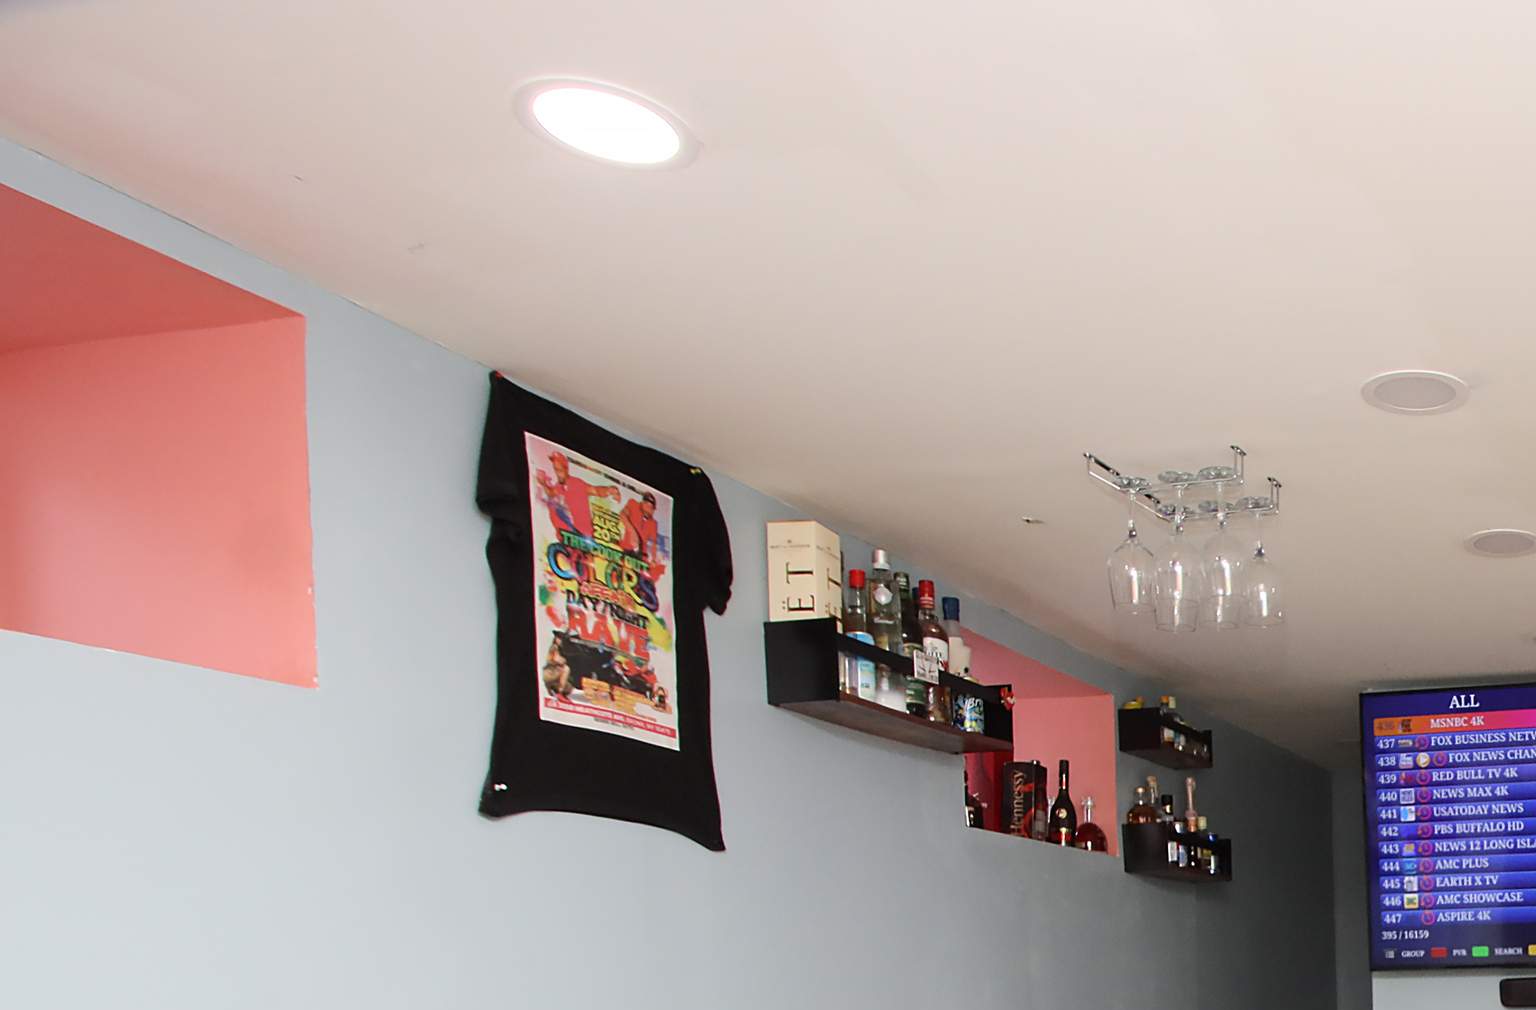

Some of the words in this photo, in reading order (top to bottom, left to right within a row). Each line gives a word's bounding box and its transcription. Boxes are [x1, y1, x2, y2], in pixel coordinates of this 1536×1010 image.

[547, 543, 659, 612] COLORS
[567, 605, 650, 661] RAVE
[1449, 694, 1479, 708] ALL
[1430, 716, 1468, 728] MSNBC
[1470, 716, 1484, 726] 4K
[1377, 739, 1395, 748] 437
[1431, 736, 1452, 746] FOX
[1455, 733, 1506, 744] BUSINESS
[1378, 756, 1396, 766] 438
[1449, 753, 1470, 763] FOX
[1472, 751, 1505, 762] NEWS
[1378, 774, 1396, 784] 439
[1432, 771, 1454, 781] RED
[1456, 769, 1484, 780] BULL
[1487, 768, 1501, 778] TV
[1504, 767, 1518, 777] 4K
[1379, 792, 1397, 801] 440
[1433, 788, 1465, 799] NEWS
[1467, 786, 1492, 797] MAX
[1495, 785, 1508, 795] 4K
[1010, 769, 1026, 837] Hennessy
[1379, 810, 1397, 819] 441
[1434, 804, 1489, 817] USATODAY
[1491, 803, 1524, 814] NEWS
[1381, 827, 1398, 836] 442
[1434, 824, 1453, 834] PBS
[1456, 822, 1505, 834] BUFFALO
[1507, 821, 1524, 831] HD
[1381, 844, 1399, 854] 443
[1435, 841, 1466, 852] NEWS
[1469, 840, 1481, 850] 12
[1484, 838, 1514, 849] LONG
[1382, 863, 1400, 872] 444
[1435, 859, 1460, 869] AMC
[1462, 858, 1489, 869] PLUS
[1383, 880, 1400, 889] 445
[1436, 876, 1472, 887] EARTH
[1475, 876, 1483, 885] X
[1484, 875, 1498, 885] TV
[1383, 897, 1401, 906] 446
[1436, 894, 1461, 905] AMC
[1463, 892, 1523, 904] SHOWCASE
[1384, 915, 1401, 924] 447
[1437, 911, 1475, 922] ASPIRE
[1476, 910, 1491, 921] 4K
[1381, 931, 1397, 940] 395
[1404, 930, 1429, 939] 16159
[1402, 950, 1424, 958] GROUP
[1494, 947, 1523, 955] SEARCH
